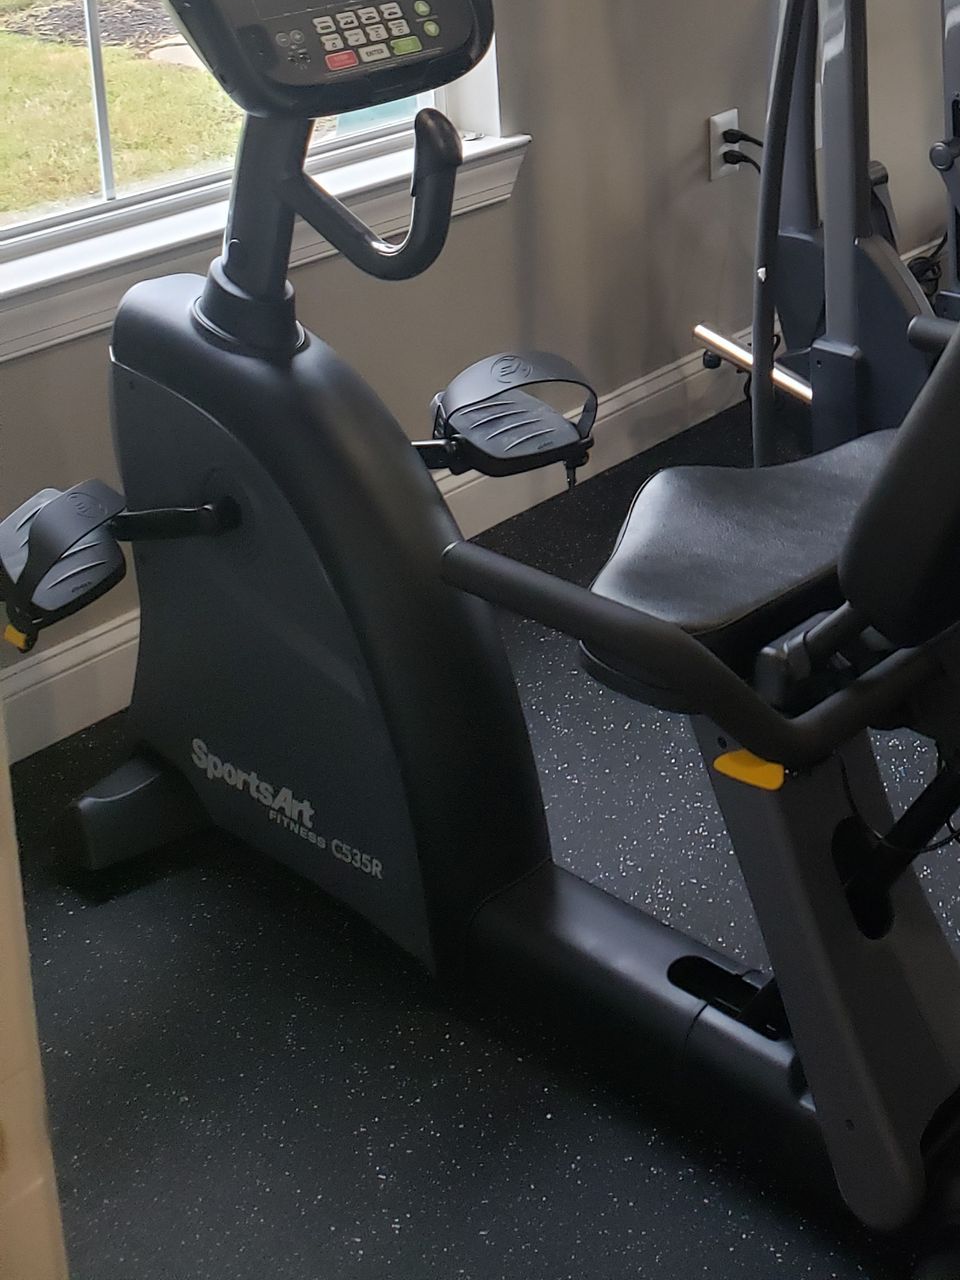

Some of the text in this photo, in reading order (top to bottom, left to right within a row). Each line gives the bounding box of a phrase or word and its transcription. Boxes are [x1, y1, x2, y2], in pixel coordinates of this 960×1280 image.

[191, 737, 315, 829] SportsArt
[268, 809, 384, 880] FITNESS C535R
